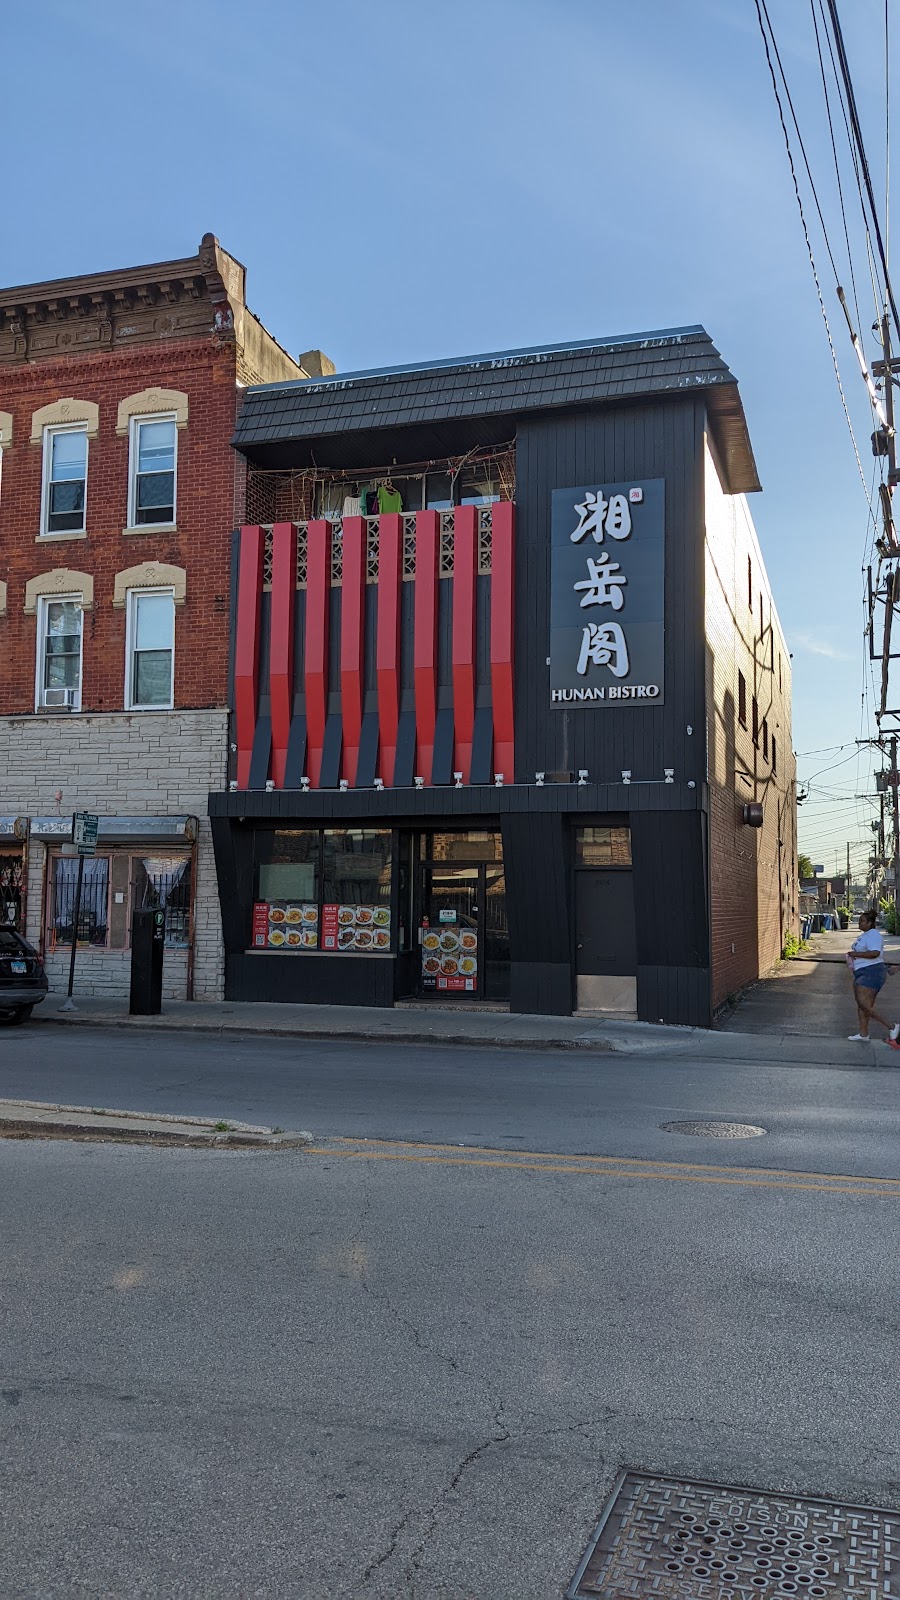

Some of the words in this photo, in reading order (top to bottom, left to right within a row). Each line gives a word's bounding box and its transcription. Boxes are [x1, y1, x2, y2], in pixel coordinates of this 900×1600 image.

[551, 687, 605, 703] HUNAN
[608, 684, 660, 700] BISTRO
[709, 1502, 809, 1529] EDISON
